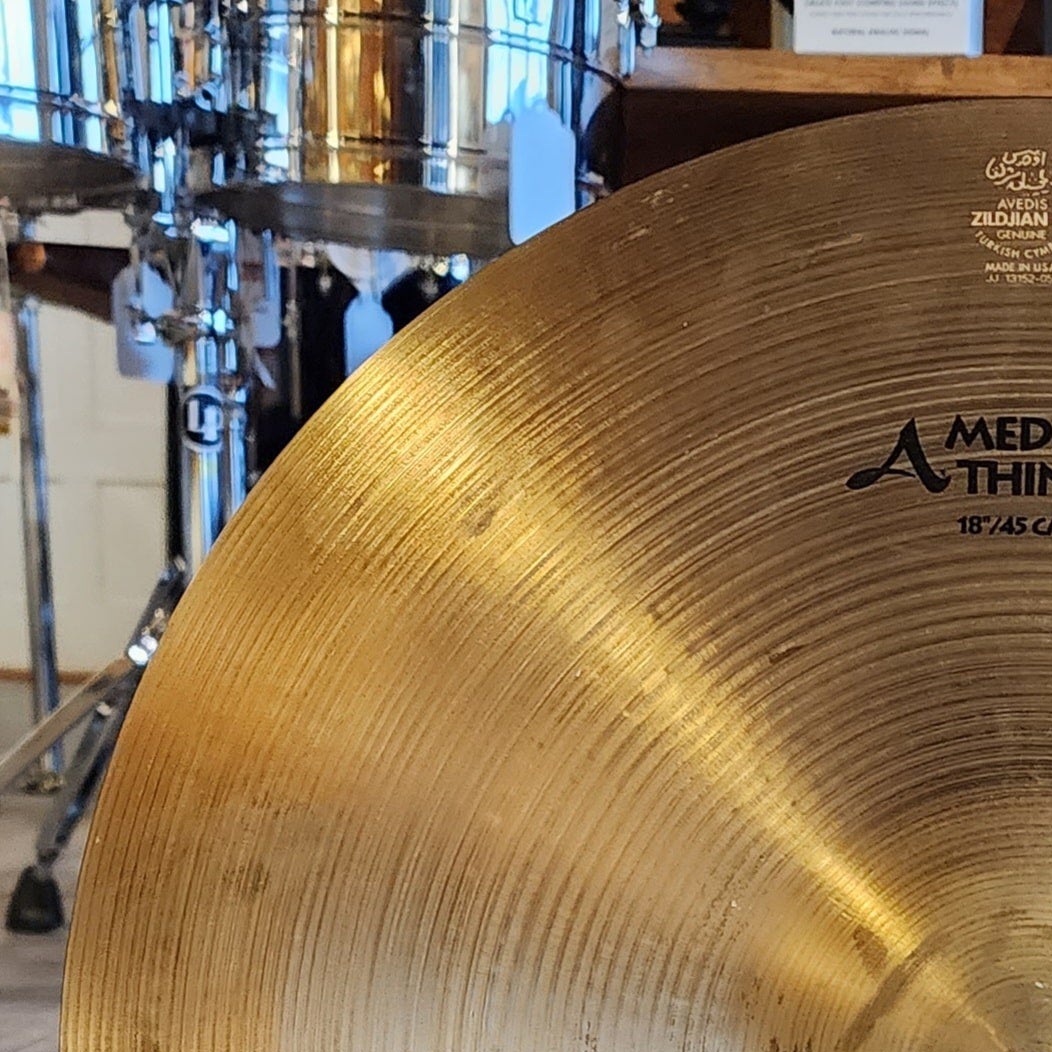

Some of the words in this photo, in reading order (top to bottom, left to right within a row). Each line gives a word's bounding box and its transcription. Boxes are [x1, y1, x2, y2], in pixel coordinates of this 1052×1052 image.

[997, 198, 1048, 210] AVEDIS
[970, 211, 1048, 227] ZILDJIAN
[996, 229, 1047, 240] GENUINE
[975, 230, 1020, 258] TURKISH
[985, 262, 1015, 273] MADE
[1018, 262, 1031, 273] IN
[845, 417, 952, 494] A
[957, 516, 1028, 536] 18"/45
